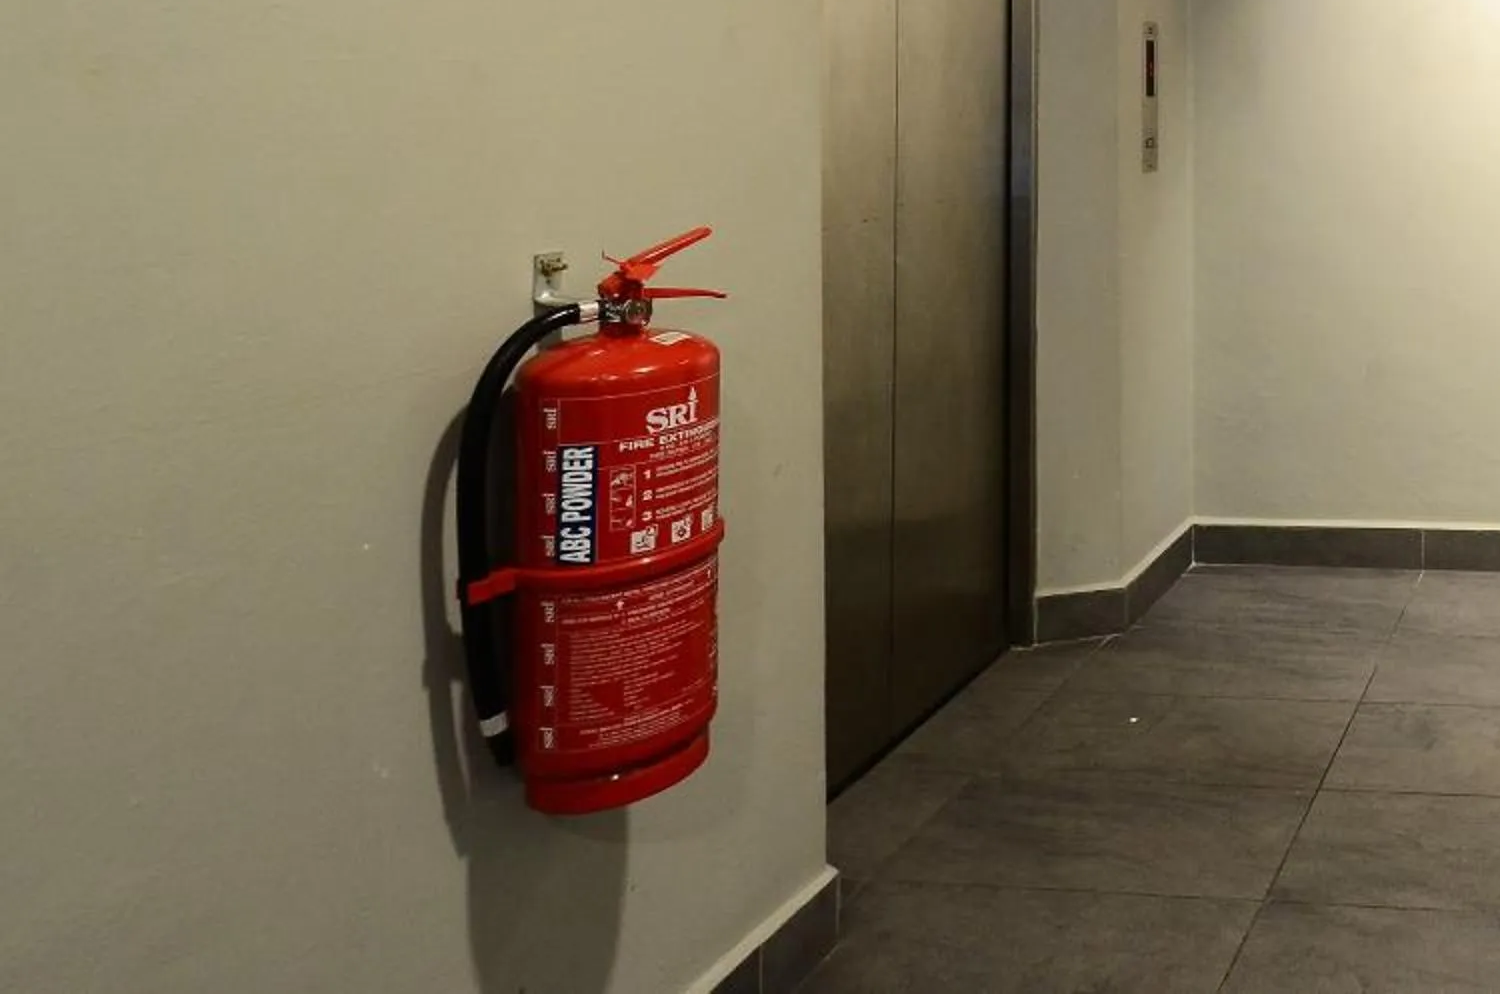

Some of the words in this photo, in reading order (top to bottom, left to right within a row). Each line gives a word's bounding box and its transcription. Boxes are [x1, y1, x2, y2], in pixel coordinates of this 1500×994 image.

[619, 437, 655, 452] FIRE
[561, 446, 595, 523] POWDER
[559, 526, 592, 563] ABC
